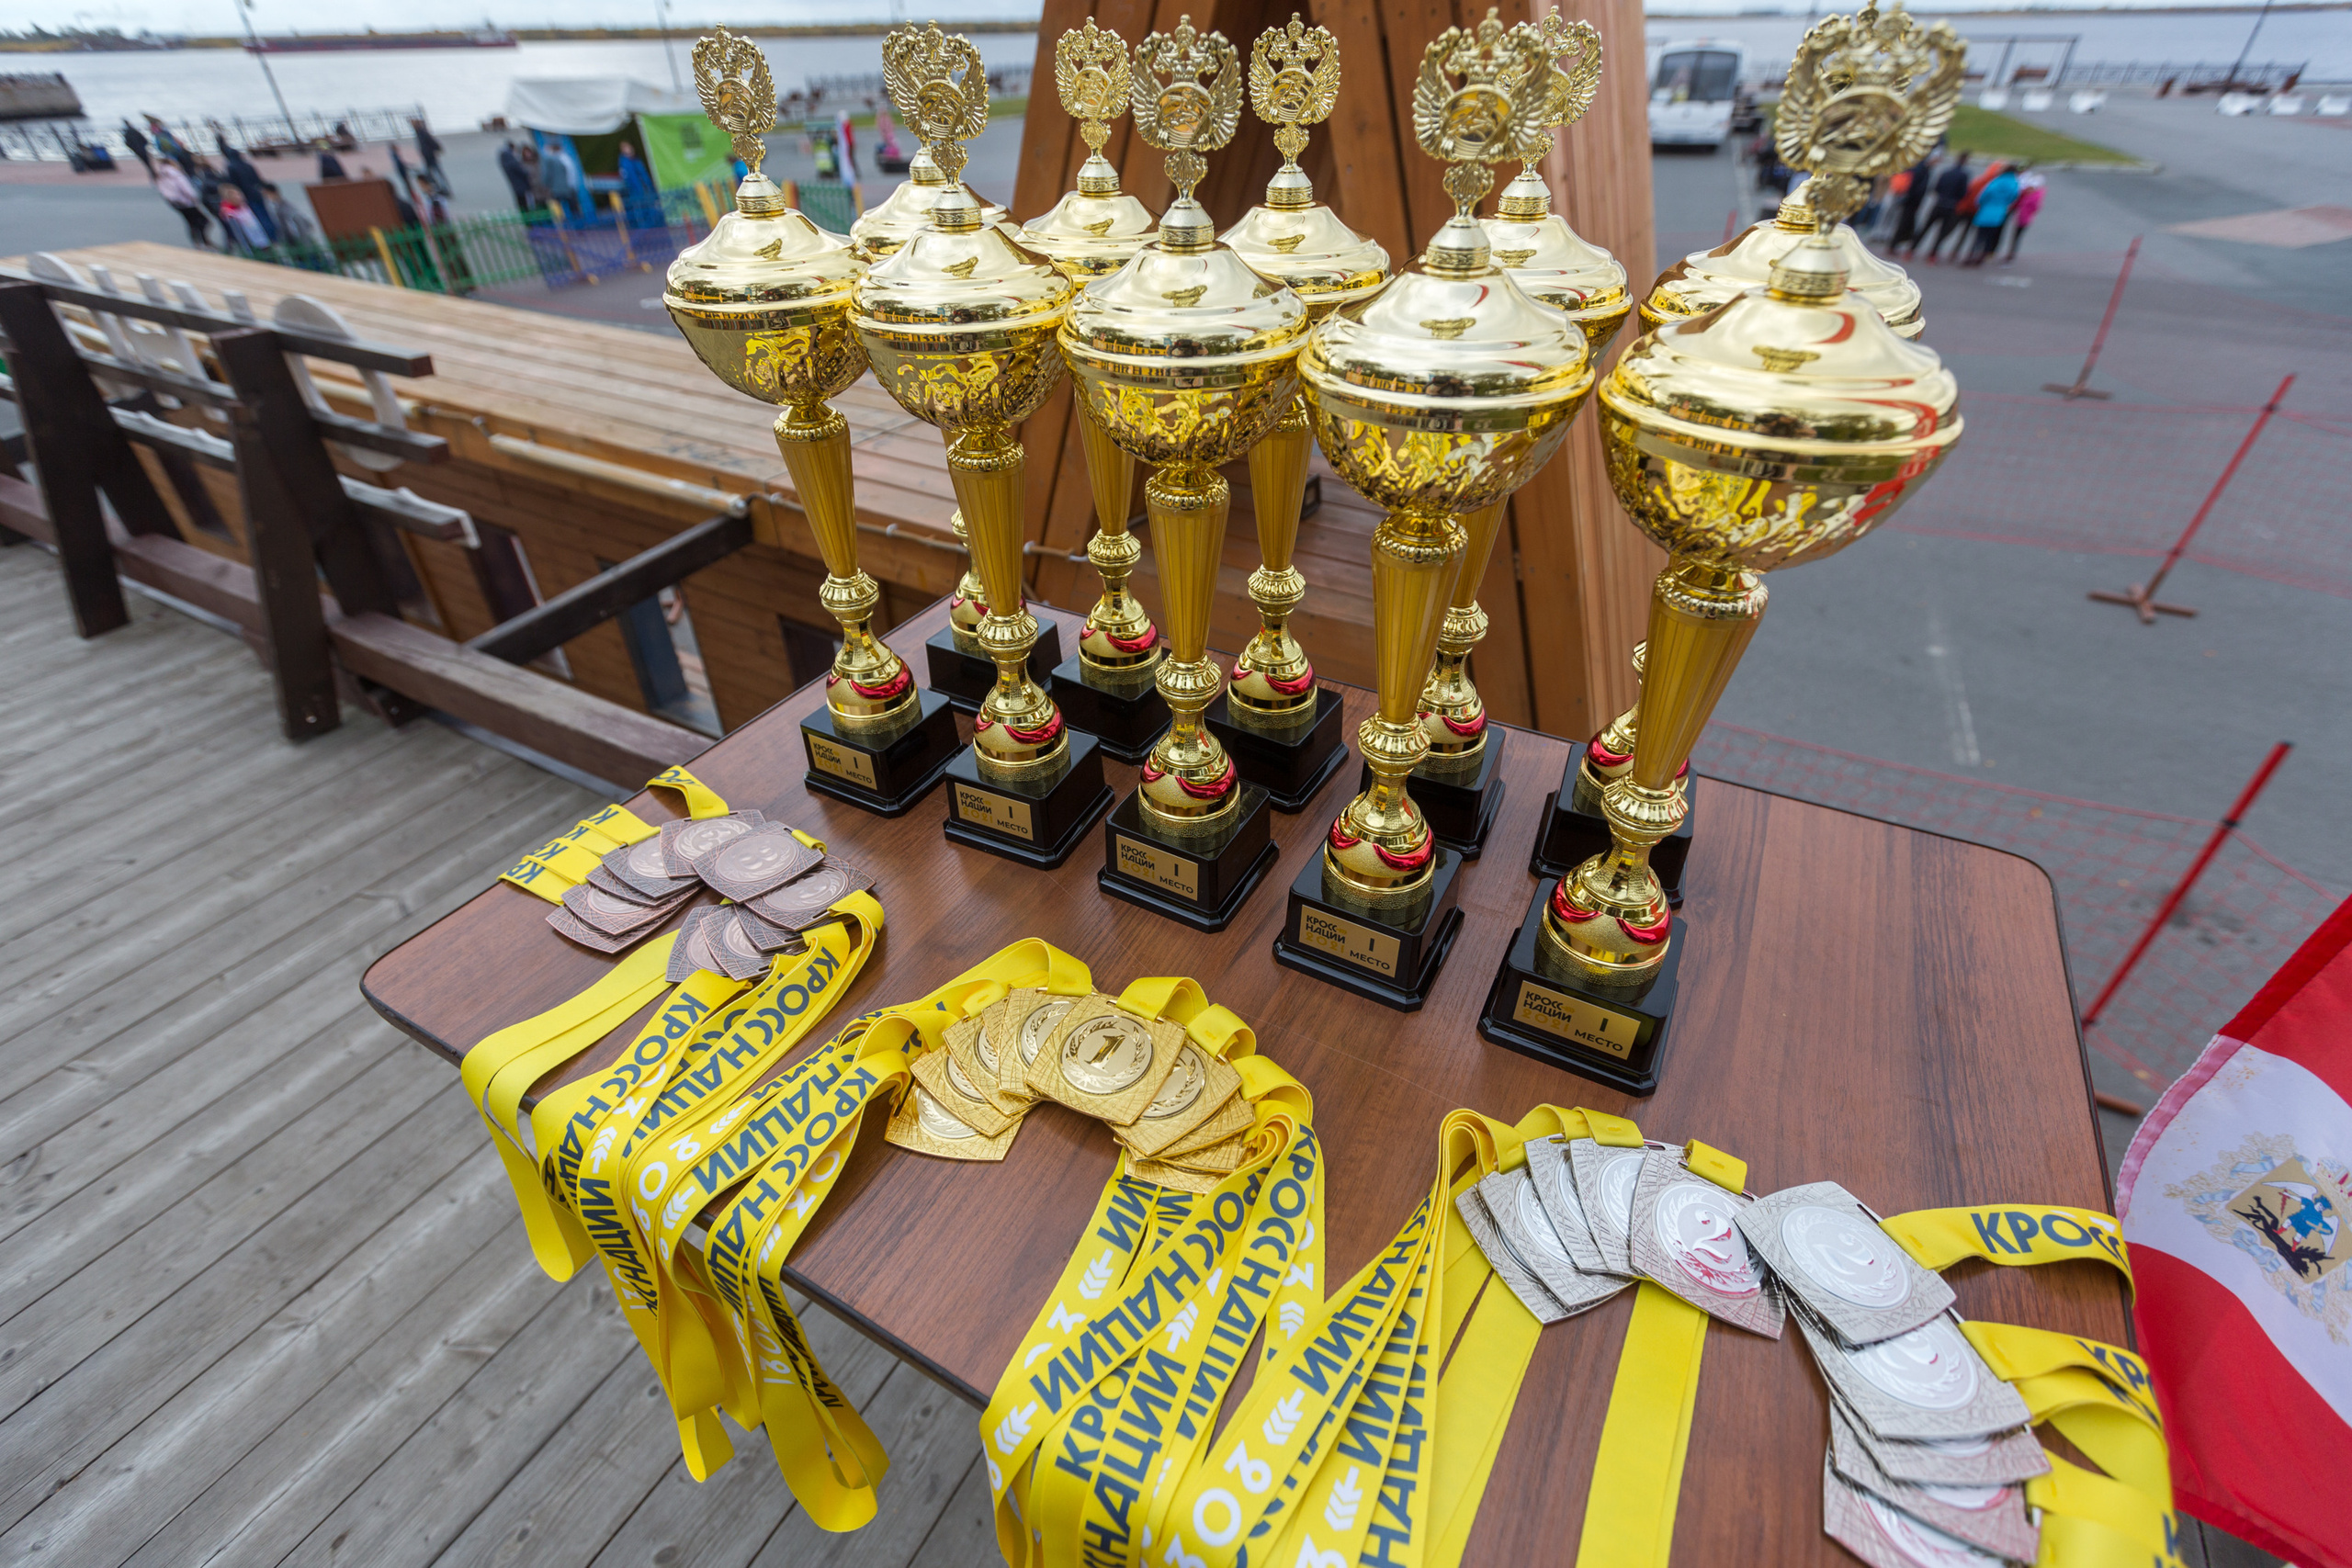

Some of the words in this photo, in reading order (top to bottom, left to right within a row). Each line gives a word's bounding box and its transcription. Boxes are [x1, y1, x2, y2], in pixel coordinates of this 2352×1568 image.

[853, 756, 859, 769] I
[845, 769, 873, 784] МЕСТО
[959, 791, 984, 805] КРОСС
[961, 798, 992, 814] НАЦИИ
[962, 807, 993, 823] 2021
[1008, 806, 1013, 818] I
[997, 819, 1028, 834] МЕСТО
[1121, 843, 1148, 860] КРОСС
[1121, 852, 1155, 870] НАЦИИ
[1122, 860, 1155, 879] 2021
[1174, 863, 1179, 876] I
[1159, 875, 1193, 894] МЕСТО
[1306, 915, 1338, 932] КРОСС
[1306, 922, 1346, 943] НАЦИИ
[1305, 931, 1346, 953] 2021
[1368, 938, 1374, 952] I
[1350, 950, 1390, 970] МЕСТО
[743, 945, 841, 1046] КРОСС
[1525, 991, 1564, 1010] КРОСС
[1523, 999, 1572, 1022] НАЦИИ
[1521, 1009, 1570, 1032] 2021
[1599, 1018, 1609, 1032] I
[604, 992, 710, 1099] КРОСС
[1574, 1030, 1623, 1051] МЕСТО
[771, 1066, 879, 1187] КРОСС
[1250, 1123, 1317, 1263] КРОСС
[580, 1177, 650, 1282] НАЦИИ
[1289, 1239, 1419, 1397] НАЦИИ
[1029, 1250, 1202, 1416] НАЦИИ
[1084, 1347, 1188, 1561] НАЦИИ
